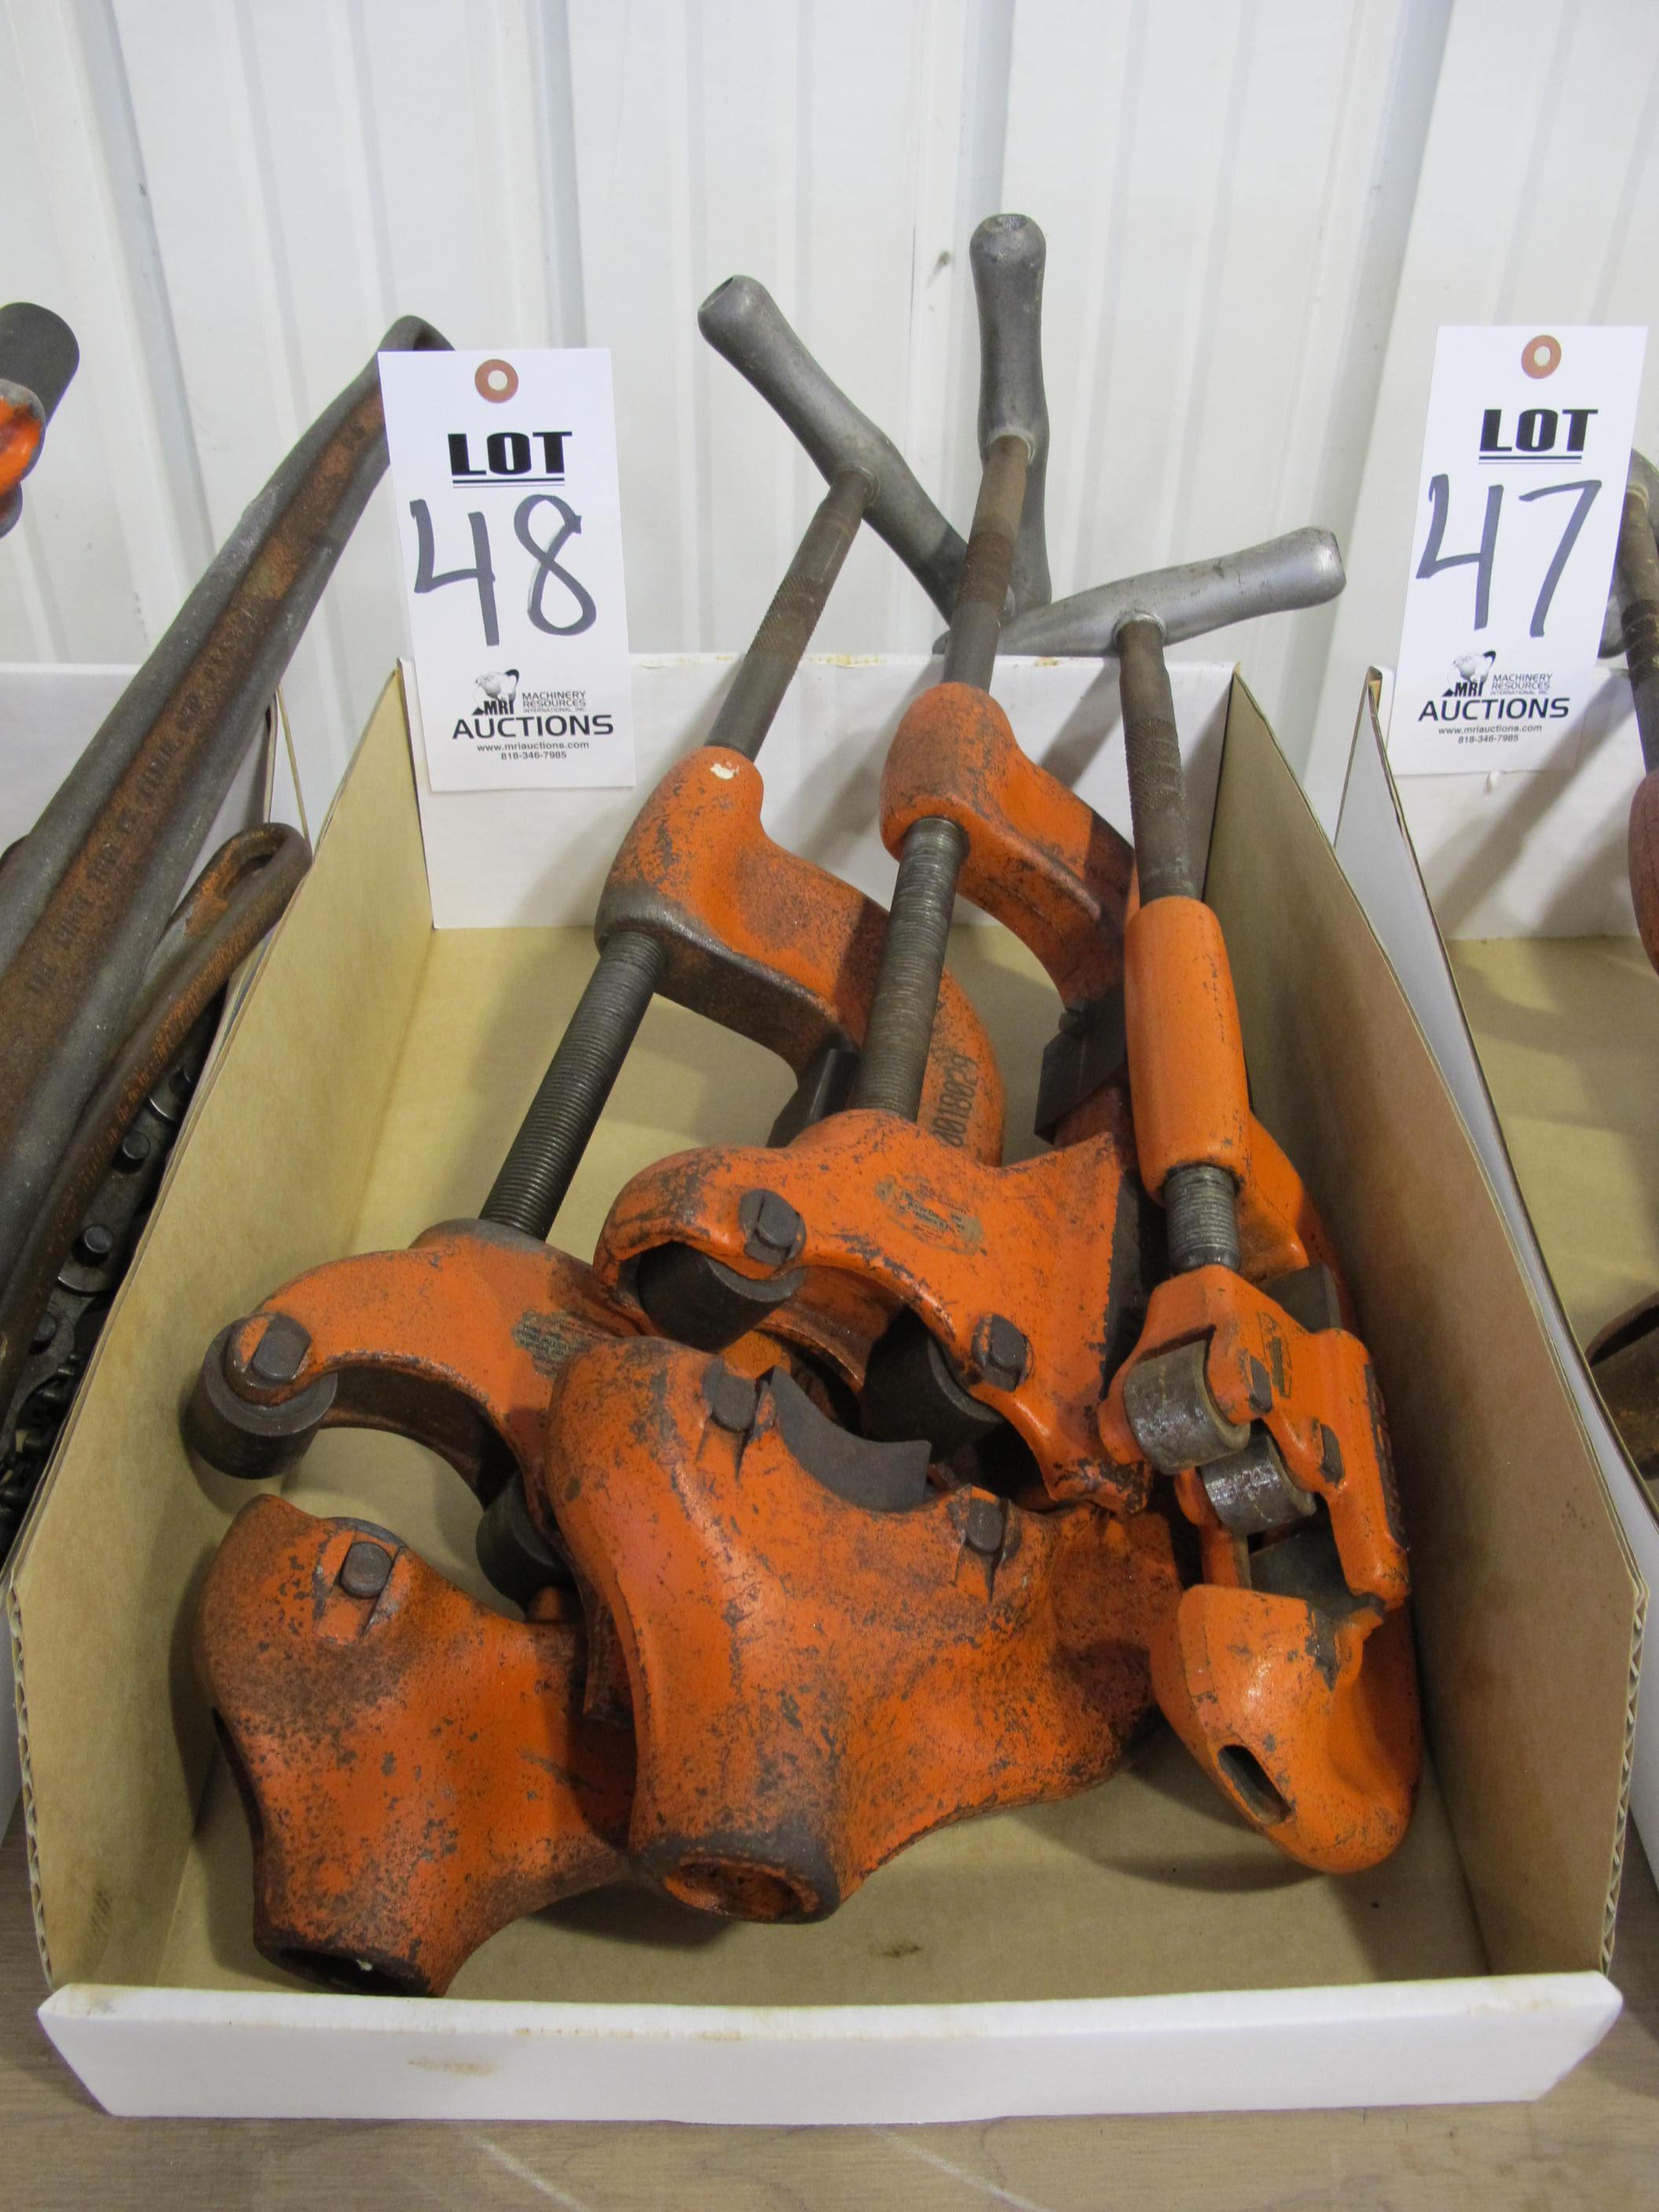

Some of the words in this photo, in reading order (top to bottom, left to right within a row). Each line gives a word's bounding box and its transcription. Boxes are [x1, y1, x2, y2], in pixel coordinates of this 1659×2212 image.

[1480, 408, 1599, 452] LOT
[447, 431, 573, 476] LOT
[1415, 473, 1602, 638] 47
[410, 494, 597, 646] 48
[1492, 673, 1553, 683] MACHINERY
[522, 690, 587, 700] MACHINERY
[1454, 680, 1485, 698] MRI
[483, 699, 515, 716] MRI
[1418, 698, 1570, 722] AUCTIONS
[452, 714, 614, 740] AUCTIONS
[1438, 723, 1543, 734] www.mriauctions.com
[477, 742, 590, 752] www.mriauctions.com
[1458, 734, 1519, 745] 818-346-7985
[500, 751, 567, 760] 818-346-7985
